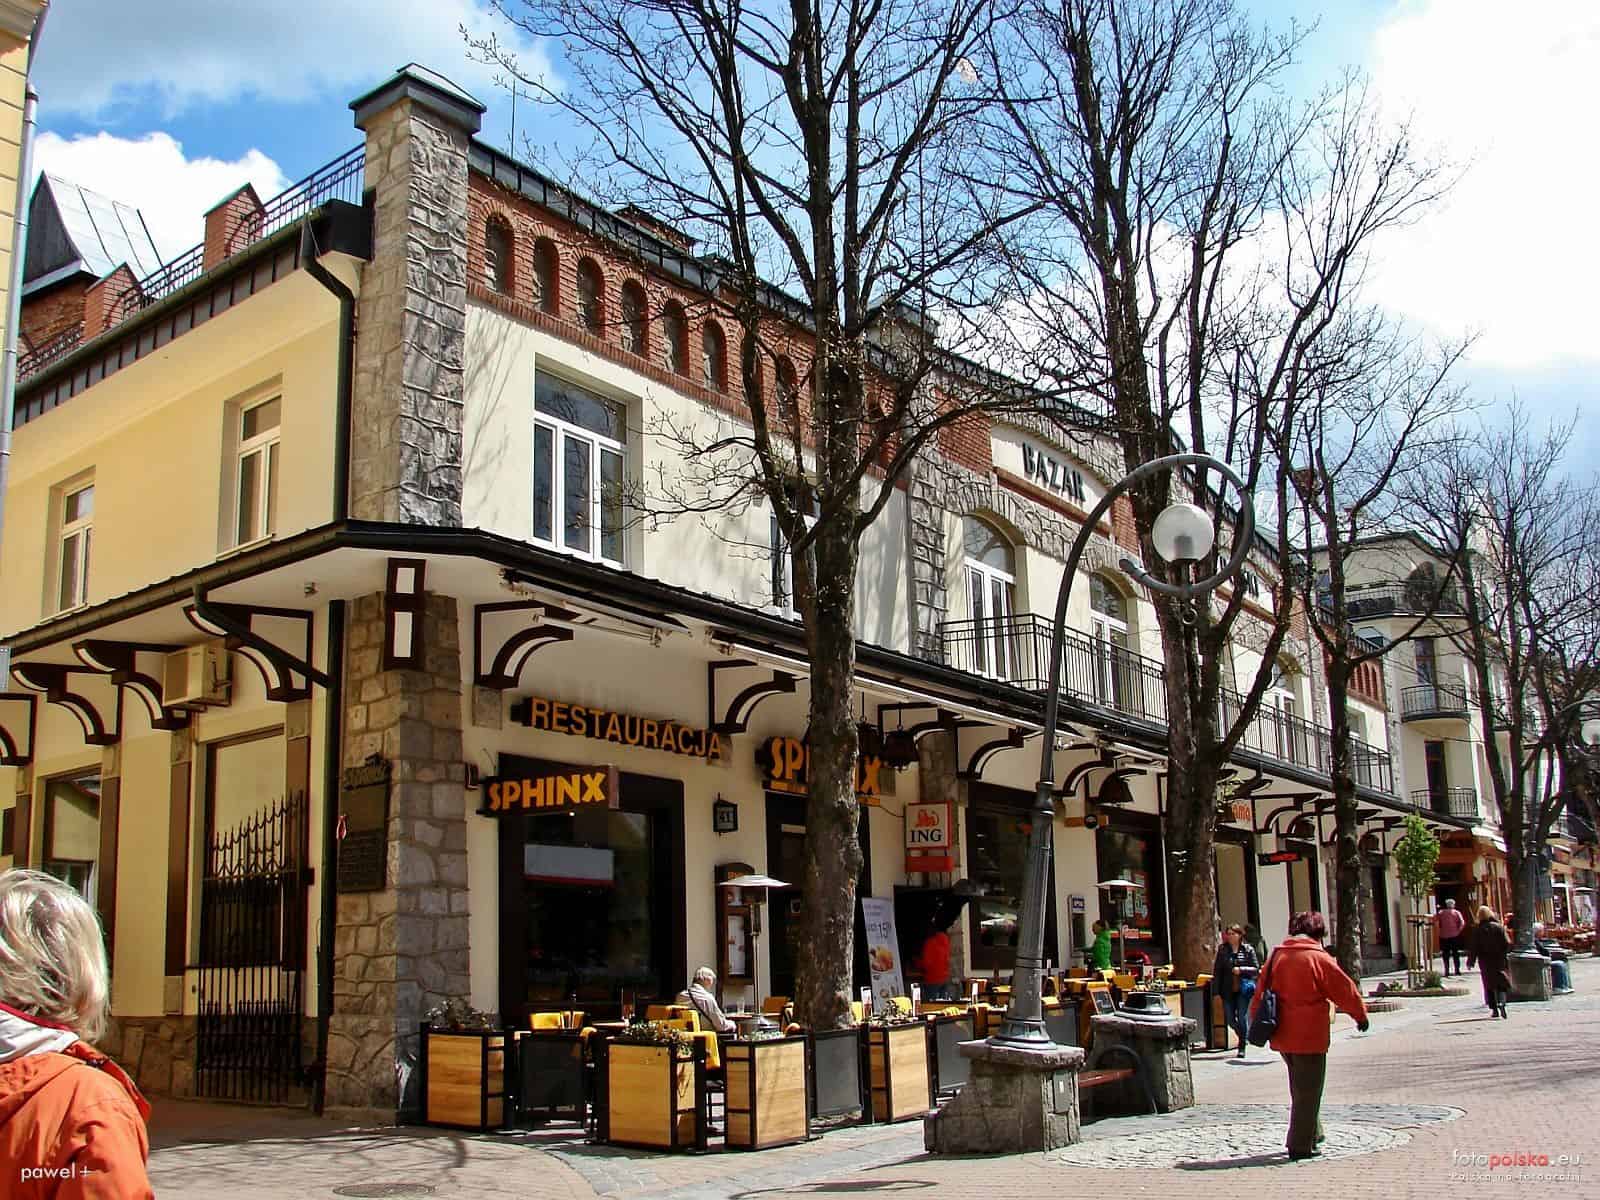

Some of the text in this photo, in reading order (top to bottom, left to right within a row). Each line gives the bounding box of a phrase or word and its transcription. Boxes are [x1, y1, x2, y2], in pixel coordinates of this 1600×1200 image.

[1022, 442, 1086, 502] BAZAR
[530, 697, 722, 756] RESTAURACJA
[490, 772, 606, 811] SPHINX
[770, 736, 881, 795] SPX
[908, 828, 943, 844] ING
